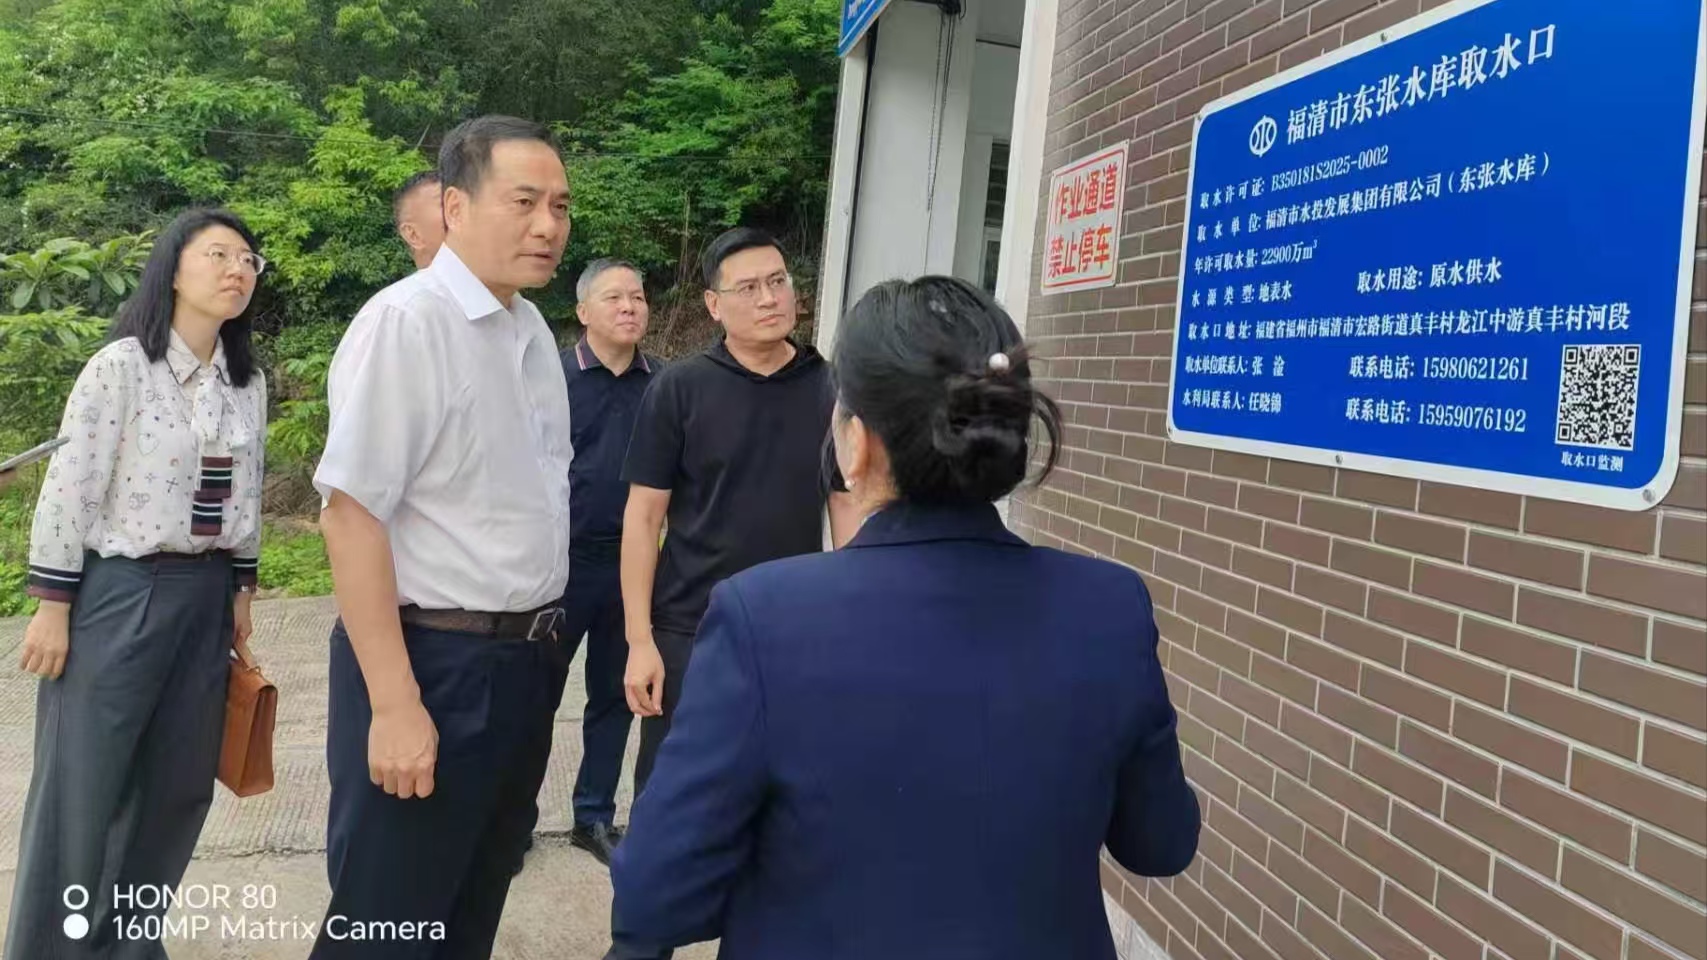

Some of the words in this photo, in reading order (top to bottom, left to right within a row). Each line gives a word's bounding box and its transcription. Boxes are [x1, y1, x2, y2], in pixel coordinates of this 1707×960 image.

[1286, 24, 1556, 146] 福清市东张水库取水口
[1055, 162, 1118, 224] 作业通道
[1048, 225, 1112, 278] 禁止停车
[1561, 451, 1625, 472] 取水口监测
